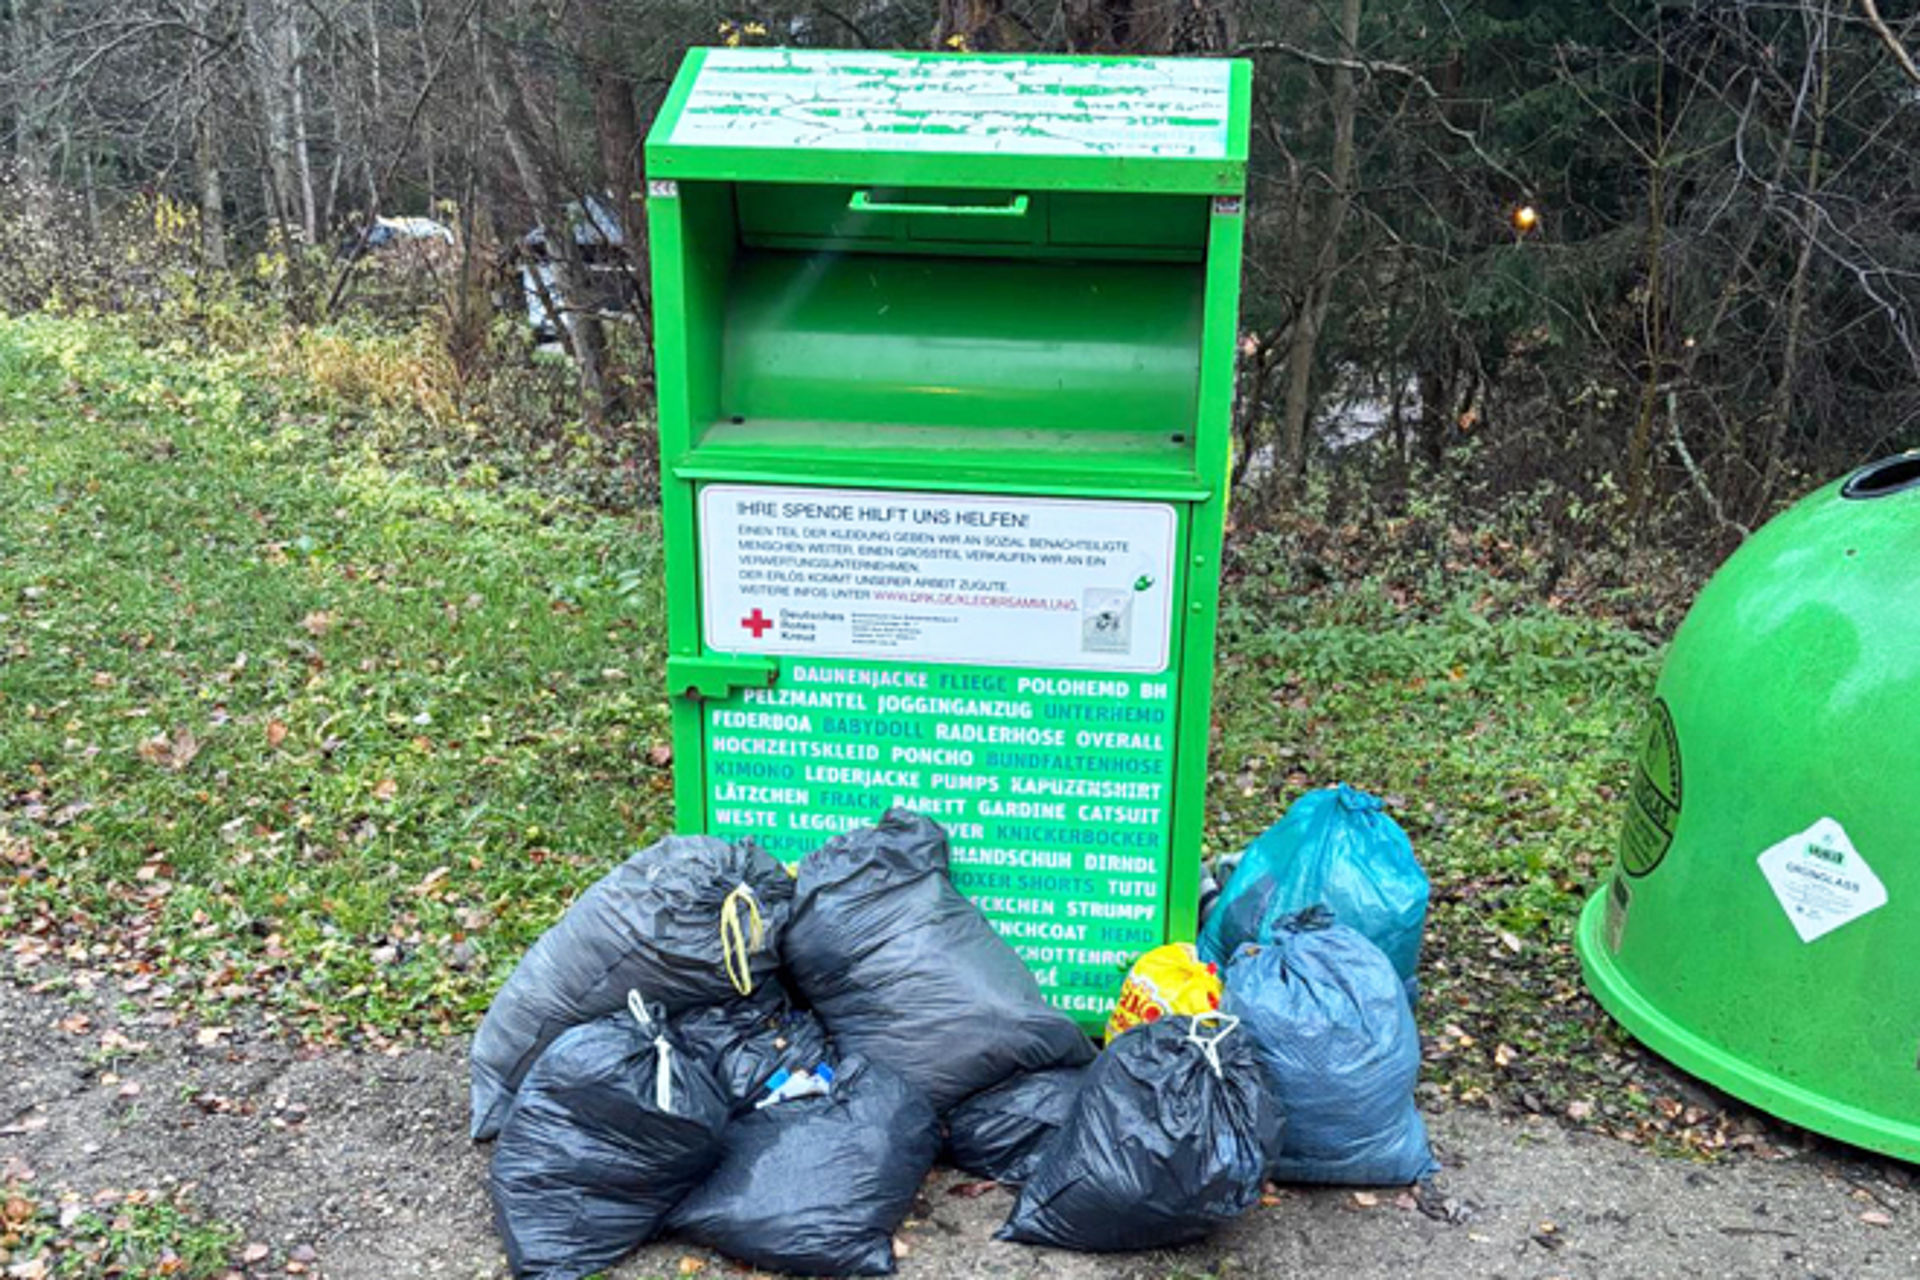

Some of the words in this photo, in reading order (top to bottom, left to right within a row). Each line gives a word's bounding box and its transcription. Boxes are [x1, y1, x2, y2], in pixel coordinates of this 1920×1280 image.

[737, 502, 777, 517] IHRE
[782, 503, 853, 520] SPENDE
[859, 506, 908, 522] HILFT
[913, 507, 950, 524] UNS
[956, 511, 1029, 528] HELFEN!
[738, 525, 772, 536] EINEN
[776, 526, 799, 537] TEIL
[803, 527, 827, 538] DER
[831, 529, 890, 542] KLEIDUNG
[893, 532, 934, 543] GEBEN
[938, 534, 960, 544] WIR
[963, 535, 981, 545] AN
[983, 536, 1024, 547] SOZIAL
[1029, 538, 1129, 552] BENACHTEILIGTE
[738, 540, 804, 552] MENSCHEN
[858, 545, 893, 556] EINEN
[896, 547, 961, 560] GROSSTEIL
[965, 551, 1036, 563] VERKAUFEN
[1040, 553, 1063, 564] WIR
[1066, 555, 1082, 565] AN
[1087, 556, 1106, 566] EIN
[739, 570, 762, 580] DER
[767, 569, 804, 582] ERLÖS
[808, 573, 849, 584] KOMMT
[855, 575, 910, 587] UNSERER
[915, 578, 955, 589] ARBEIT
[739, 584, 789, 596] WEITERE
[794, 586, 828, 597] INFOS
[832, 588, 870, 600] UNTER
[779, 608, 844, 622] Deutsches
[779, 620, 815, 631] Rotes
[780, 631, 815, 642] Kreuz
[793, 665, 928, 688] DAUNENJACKE
[939, 674, 1007, 693] FLIEGE
[1017, 677, 1130, 698] POLOHEMD
[1140, 683, 1168, 699] BH
[743, 688, 867, 711] PELZMANTEL
[877, 694, 1032, 719] JOGGINGANZUG
[1044, 703, 1165, 724] UNTERHEMD
[712, 710, 812, 733] FEDERBOA
[823, 716, 924, 739] BABYDOLL
[935, 723, 1065, 746] RADLERHOSE
[1076, 730, 1163, 751] OVERALL
[712, 736, 879, 761] HOCHZEITSKLEID
[891, 746, 974, 766] PONCHO
[985, 752, 1163, 775] BUNDFALTENHOSE
[714, 761, 795, 780] KIMONO
[804, 765, 921, 789] LEDERJACKE
[931, 773, 999, 792] PUMPS
[1011, 776, 1162, 800] KAPUZENSHIRT
[715, 781, 809, 806] LÄTZCHEN
[819, 790, 880, 809] FRACK
[892, 794, 967, 815] BARETT
[977, 799, 1066, 820] GARDINE
[1078, 804, 1161, 824] CATSUIT
[716, 808, 777, 827] WESTE
[996, 825, 1159, 848] KNICKERBOCKER
[953, 846, 1071, 869] HANDSCHUH
[1084, 853, 1157, 873] DIRNDL
[1018, 875, 1094, 894] SHORTS
[1107, 880, 1157, 897] TUTU
[1067, 901, 1156, 921] STRUMPF
[1101, 927, 1156, 943] HEMD
